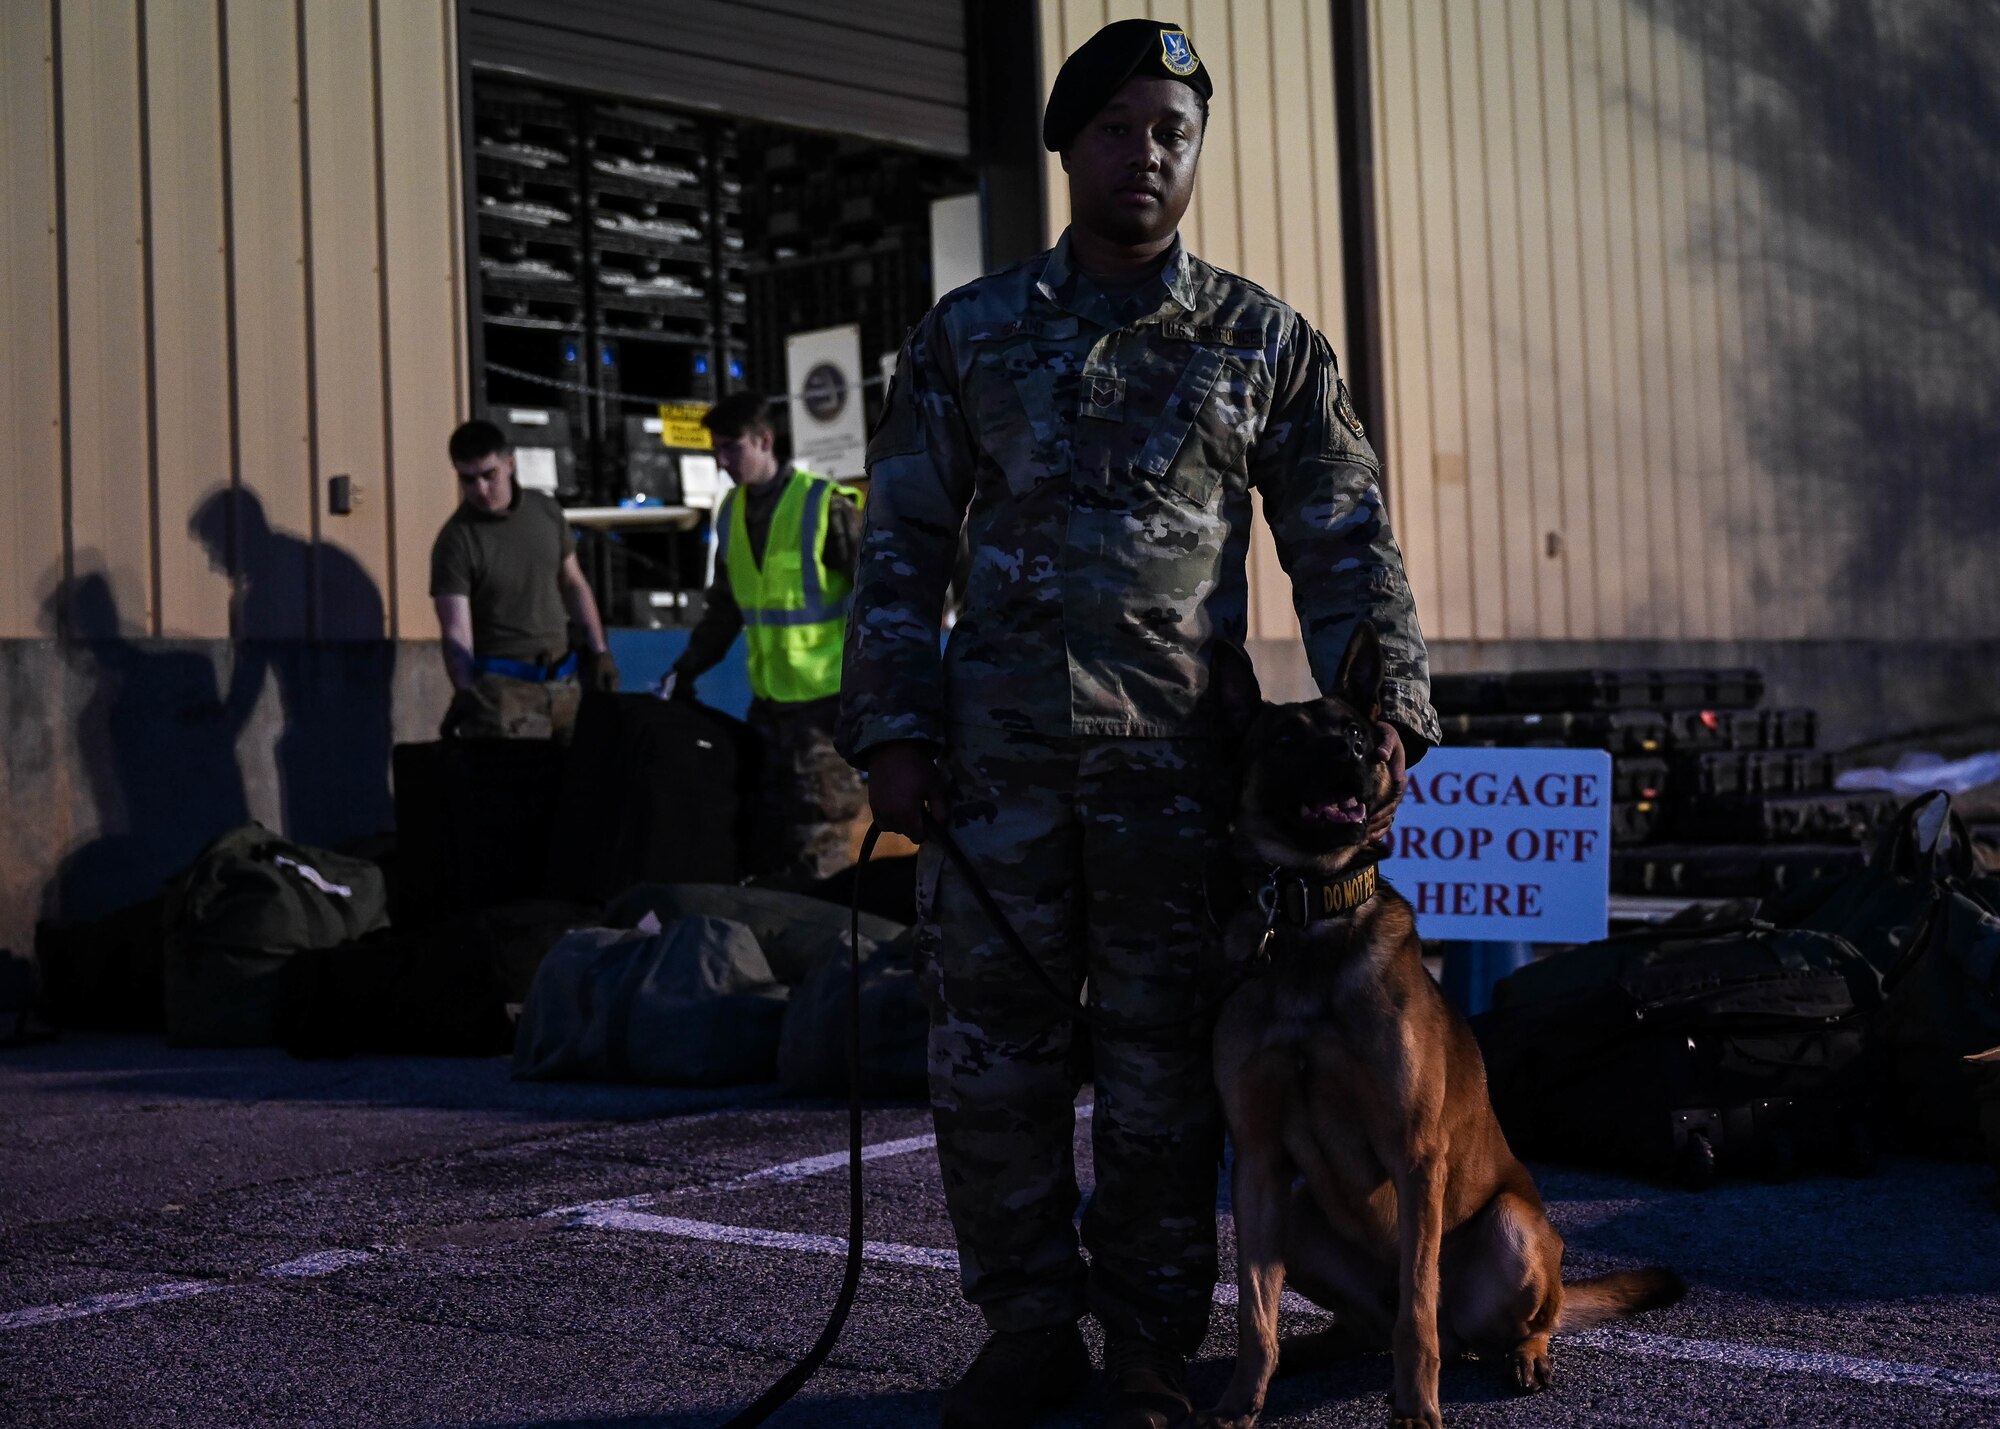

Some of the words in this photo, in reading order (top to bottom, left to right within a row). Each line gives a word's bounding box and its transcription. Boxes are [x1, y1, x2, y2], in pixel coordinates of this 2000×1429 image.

[1401, 772, 1598, 808] AGGAGE
[1506, 828, 1598, 863] OFF
[1323, 884, 1342, 912] DO
[1343, 874, 1363, 909] NOT
[1364, 865, 1376, 899] PET
[1416, 882, 1542, 917] HERE
